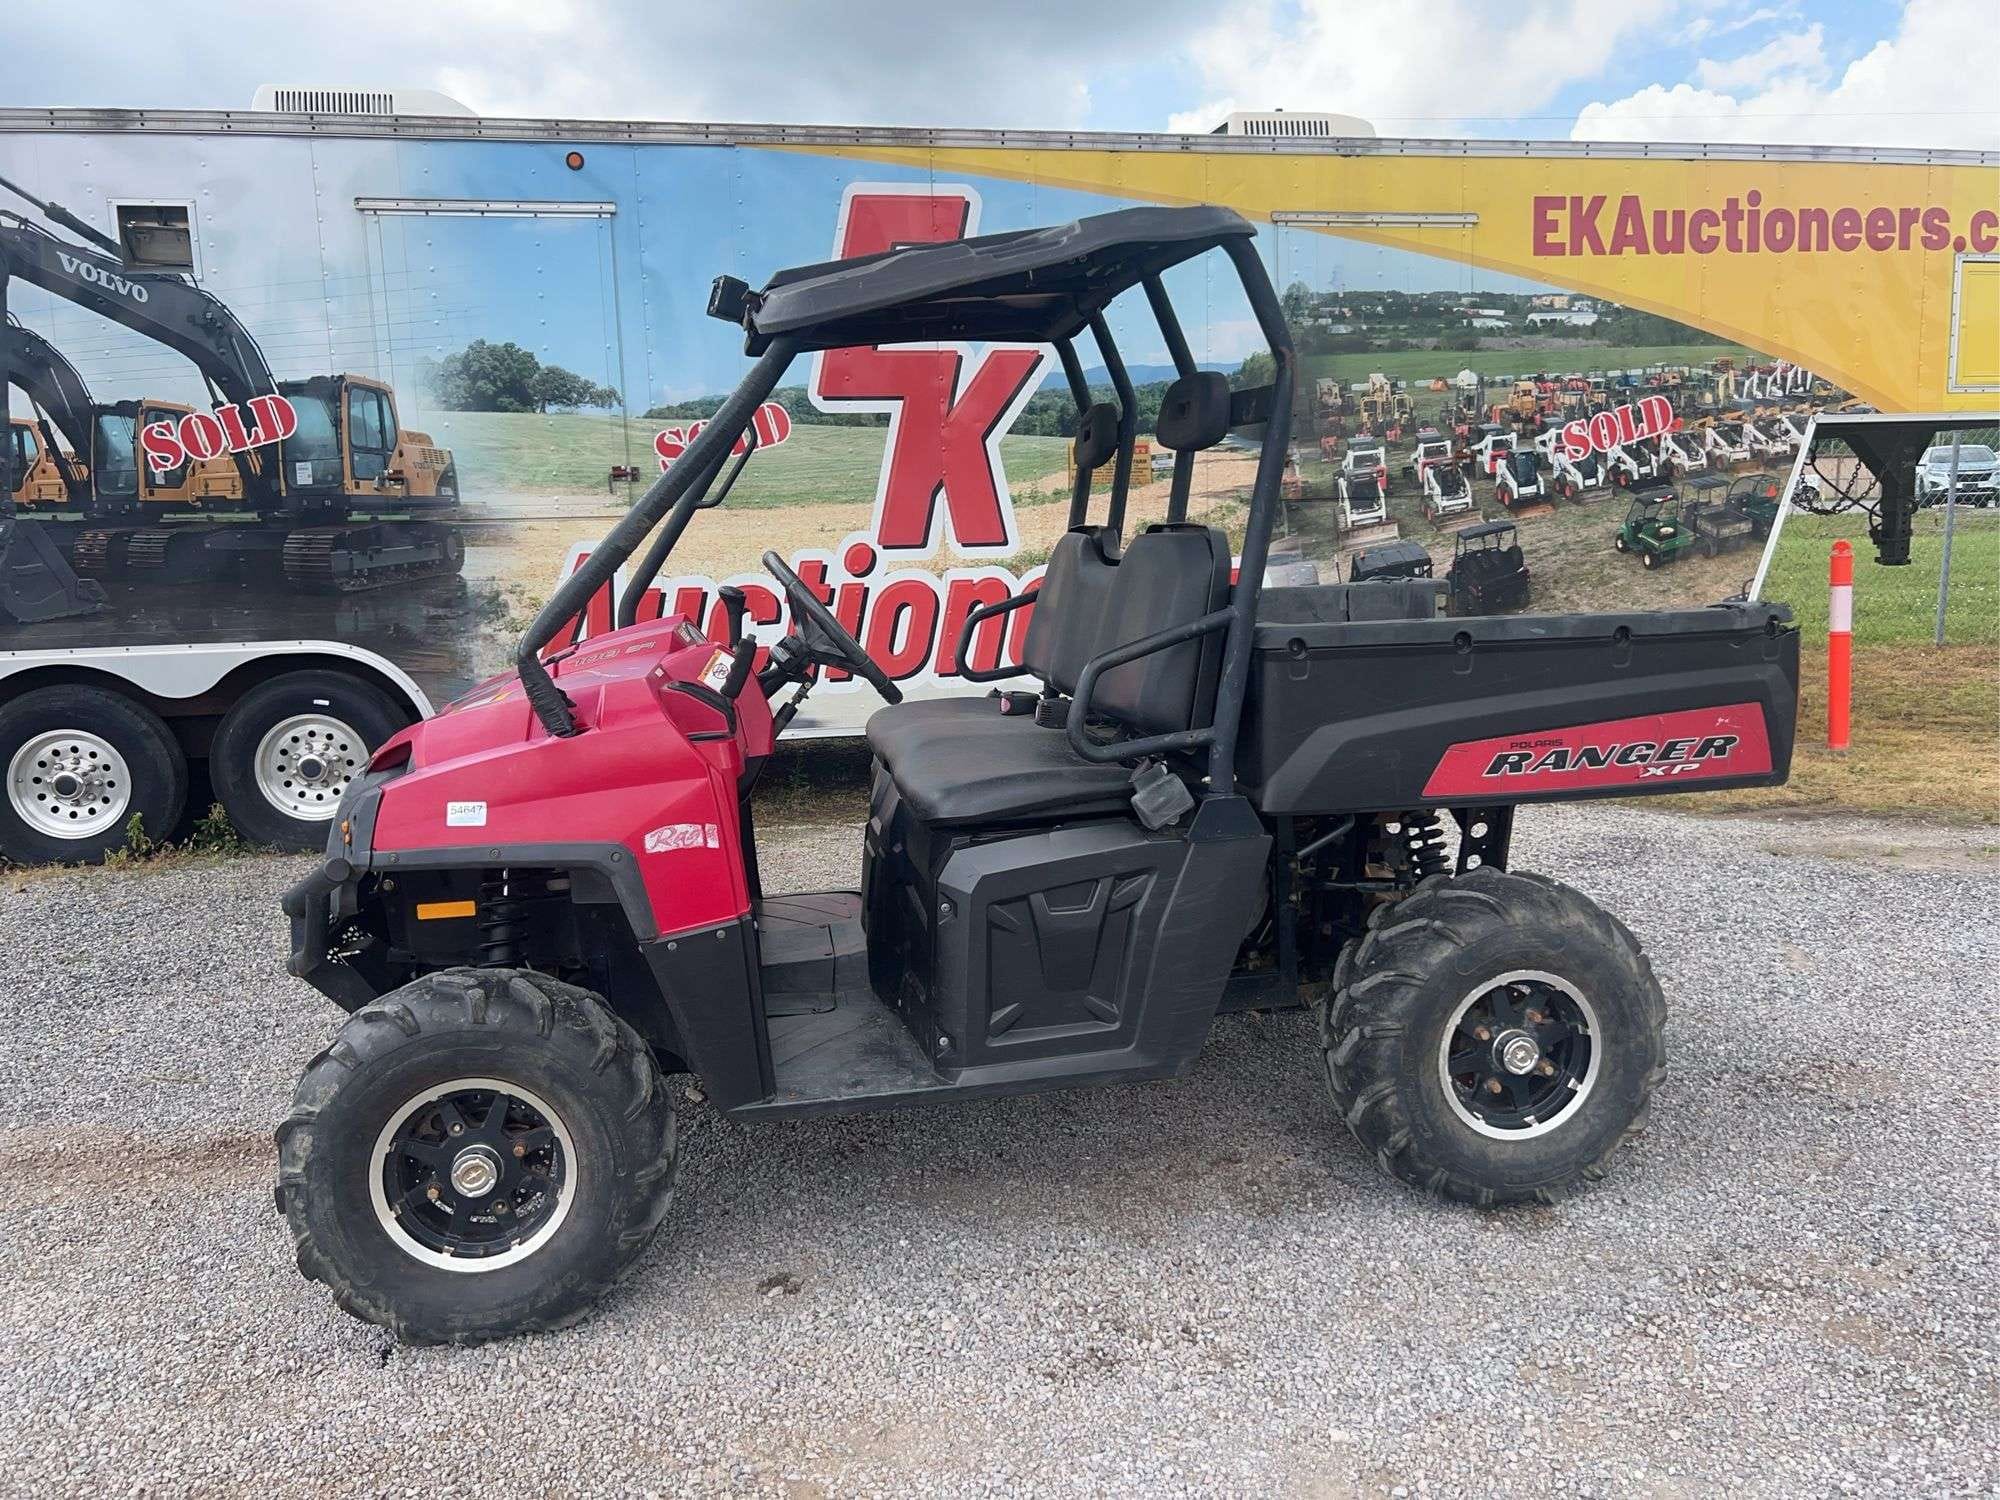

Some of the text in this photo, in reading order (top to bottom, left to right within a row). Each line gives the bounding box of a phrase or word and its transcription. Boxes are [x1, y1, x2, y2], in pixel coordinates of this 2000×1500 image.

[56, 251, 149, 303] VOLVO
[141, 394, 297, 473] SOLD
[654, 403, 791, 472] SD
[1562, 395, 1673, 463] SOLD
[1481, 735, 1740, 777] RANGER
[1510, 738, 1564, 750] POLARIS
[1638, 762, 1700, 778] XP
[450, 804, 484, 815] 54647
